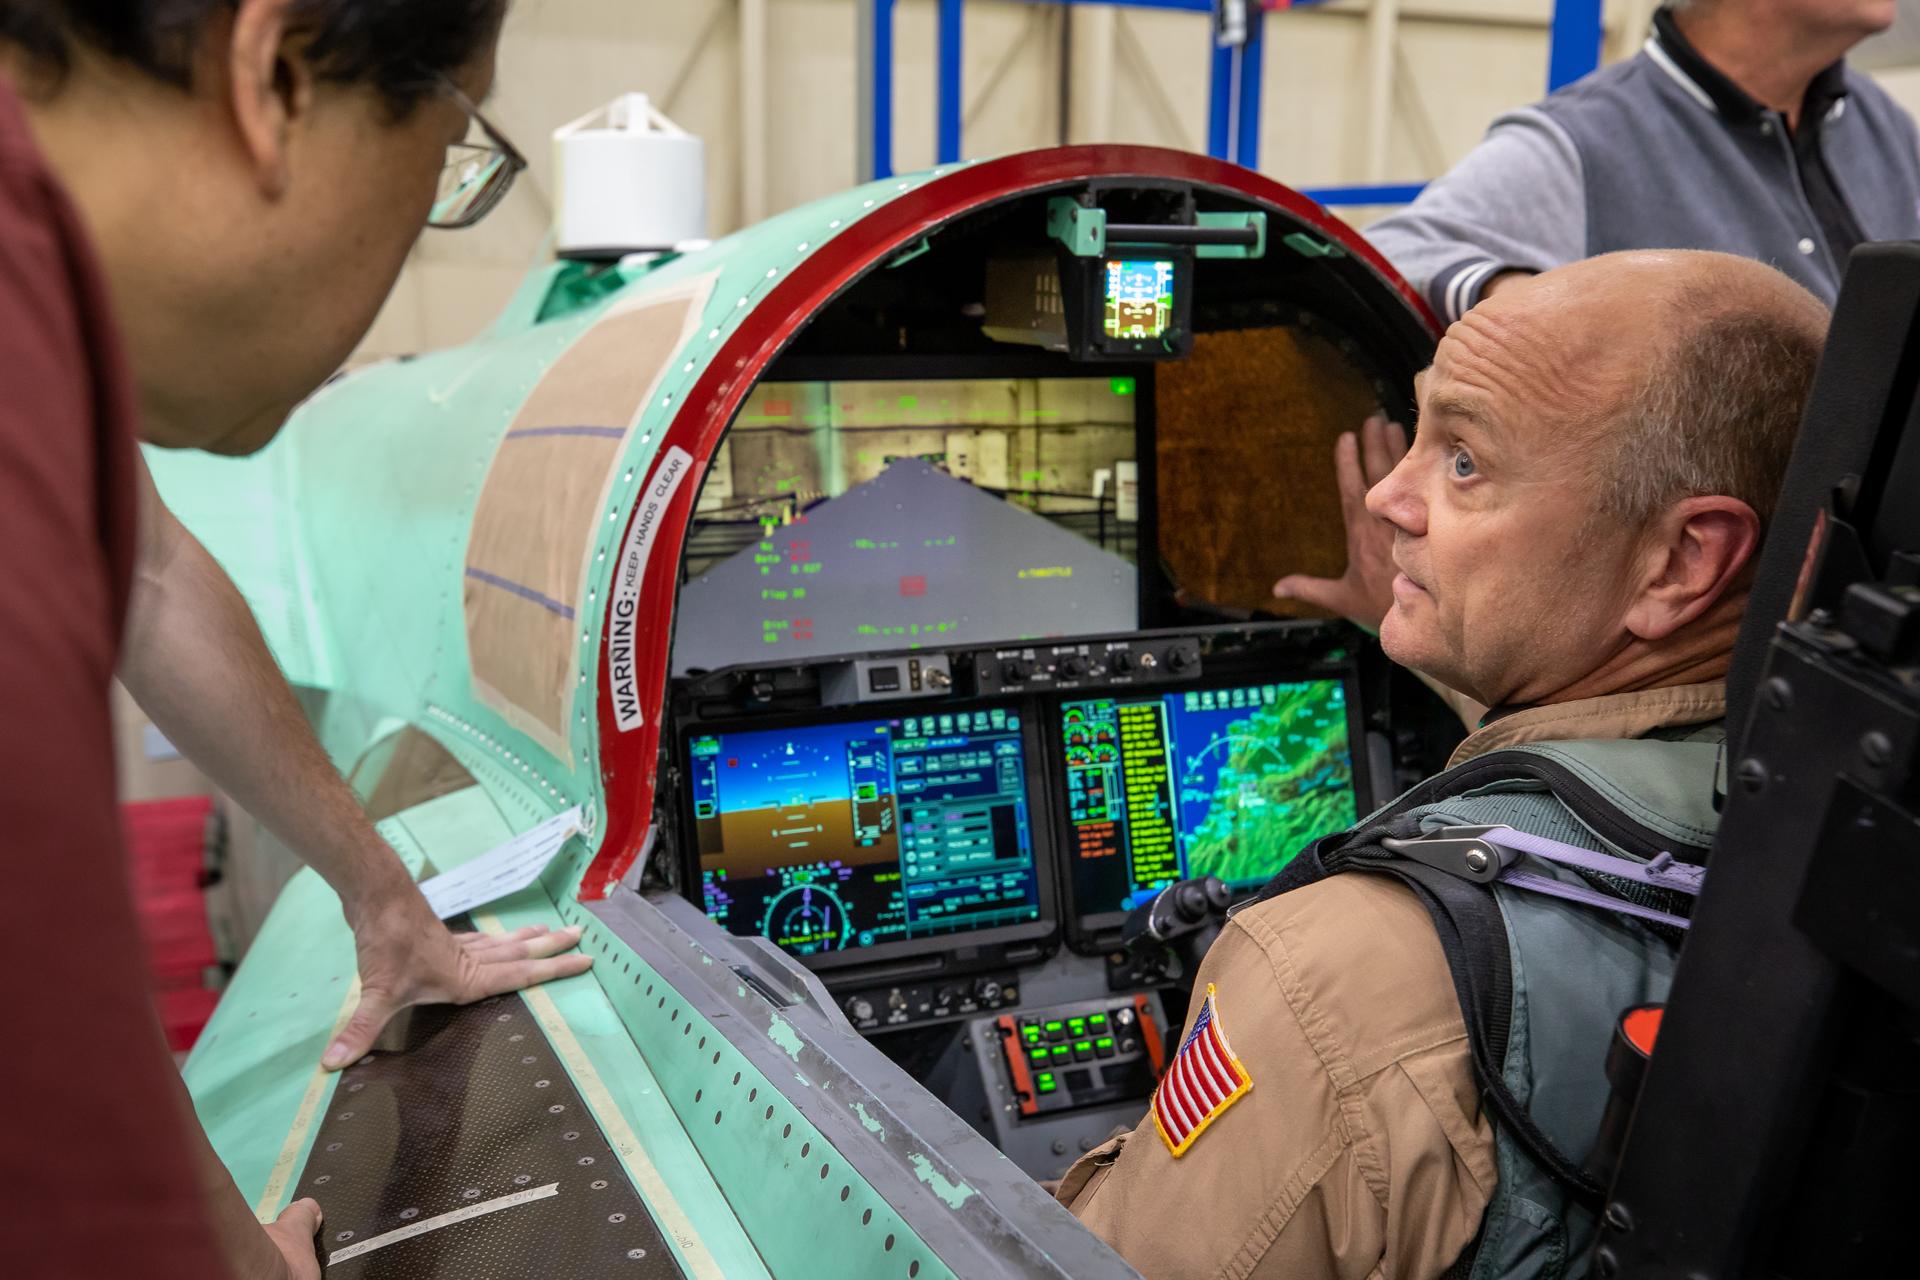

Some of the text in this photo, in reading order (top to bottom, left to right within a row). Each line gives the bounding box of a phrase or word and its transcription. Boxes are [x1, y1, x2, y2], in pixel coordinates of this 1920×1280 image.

[614, 458, 682, 722] WARNING: KEEP HANDS CLEAR
